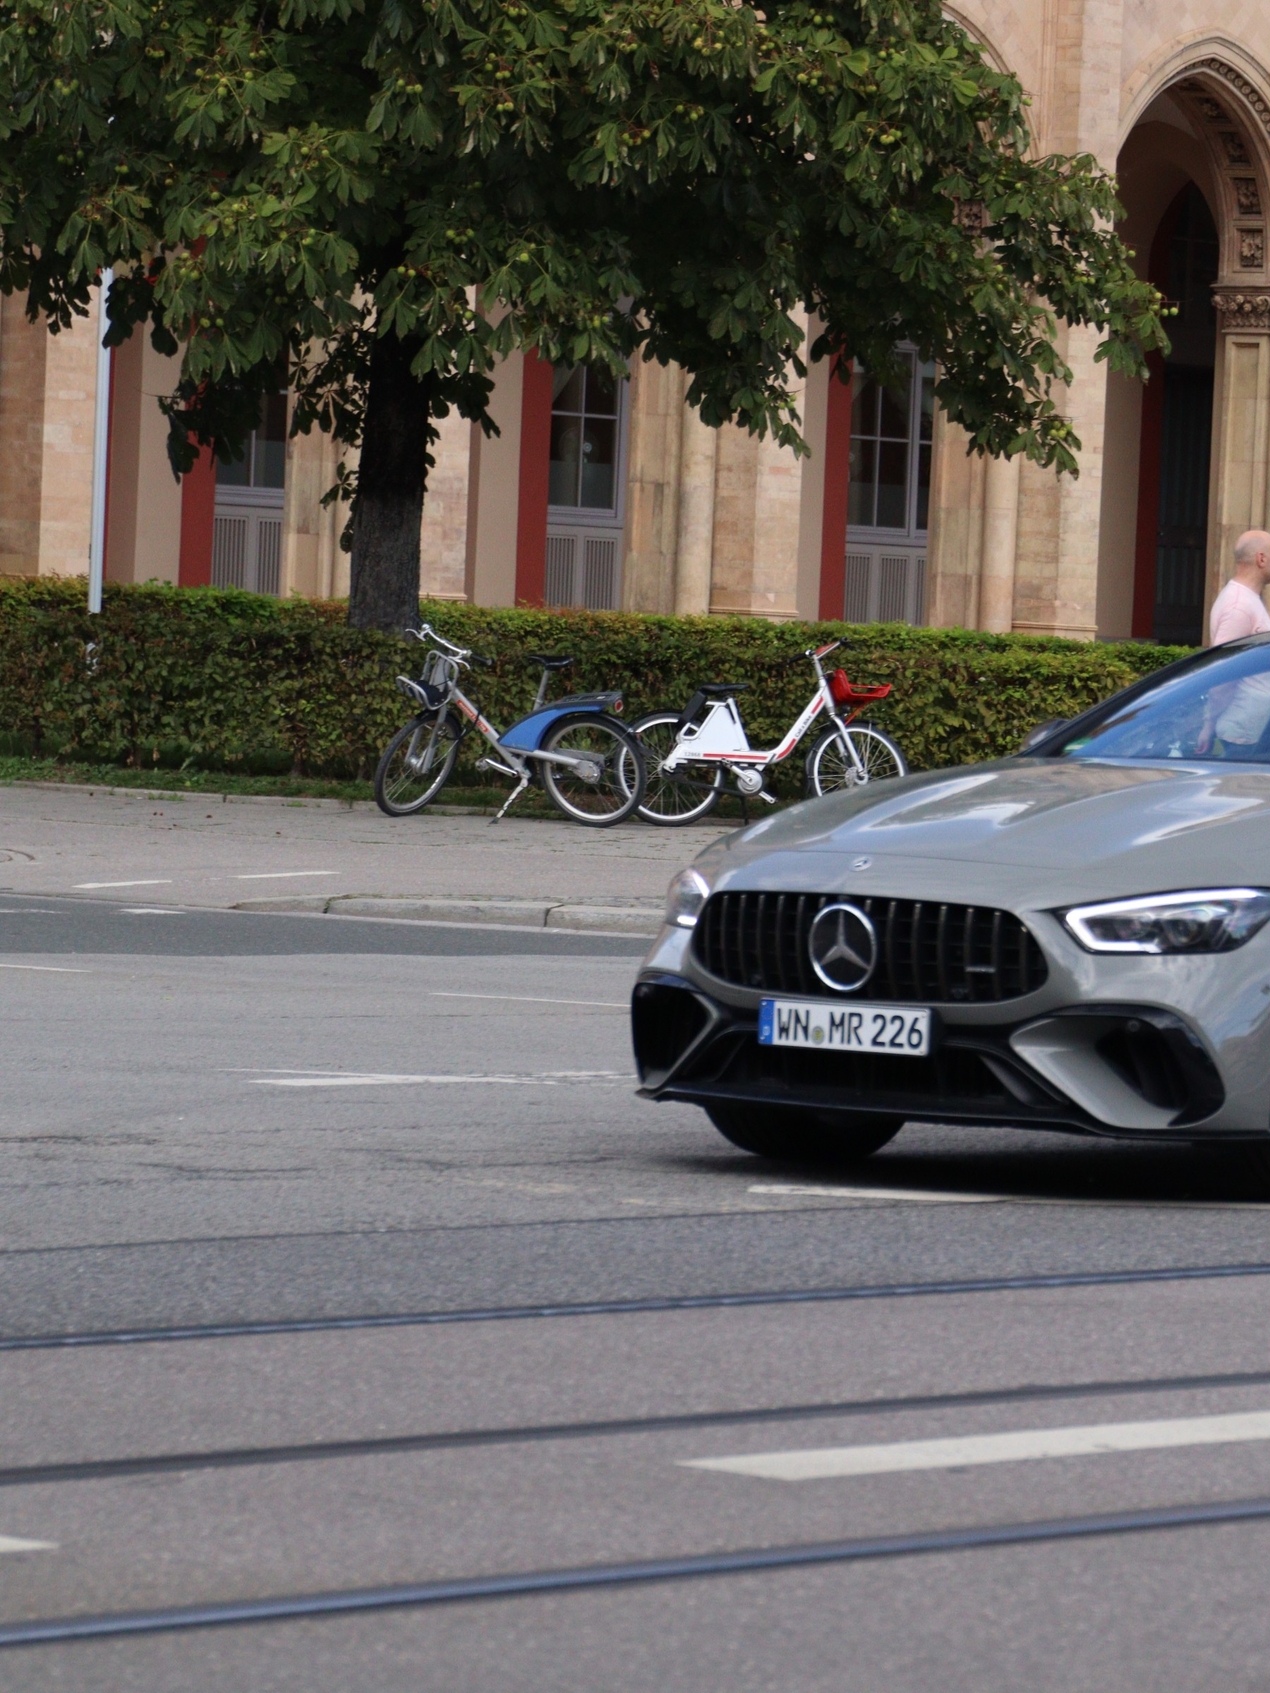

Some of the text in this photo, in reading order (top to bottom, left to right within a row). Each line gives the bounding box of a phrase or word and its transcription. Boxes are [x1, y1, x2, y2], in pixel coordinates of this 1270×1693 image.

[777, 1008, 923, 1049] WN MR 226
